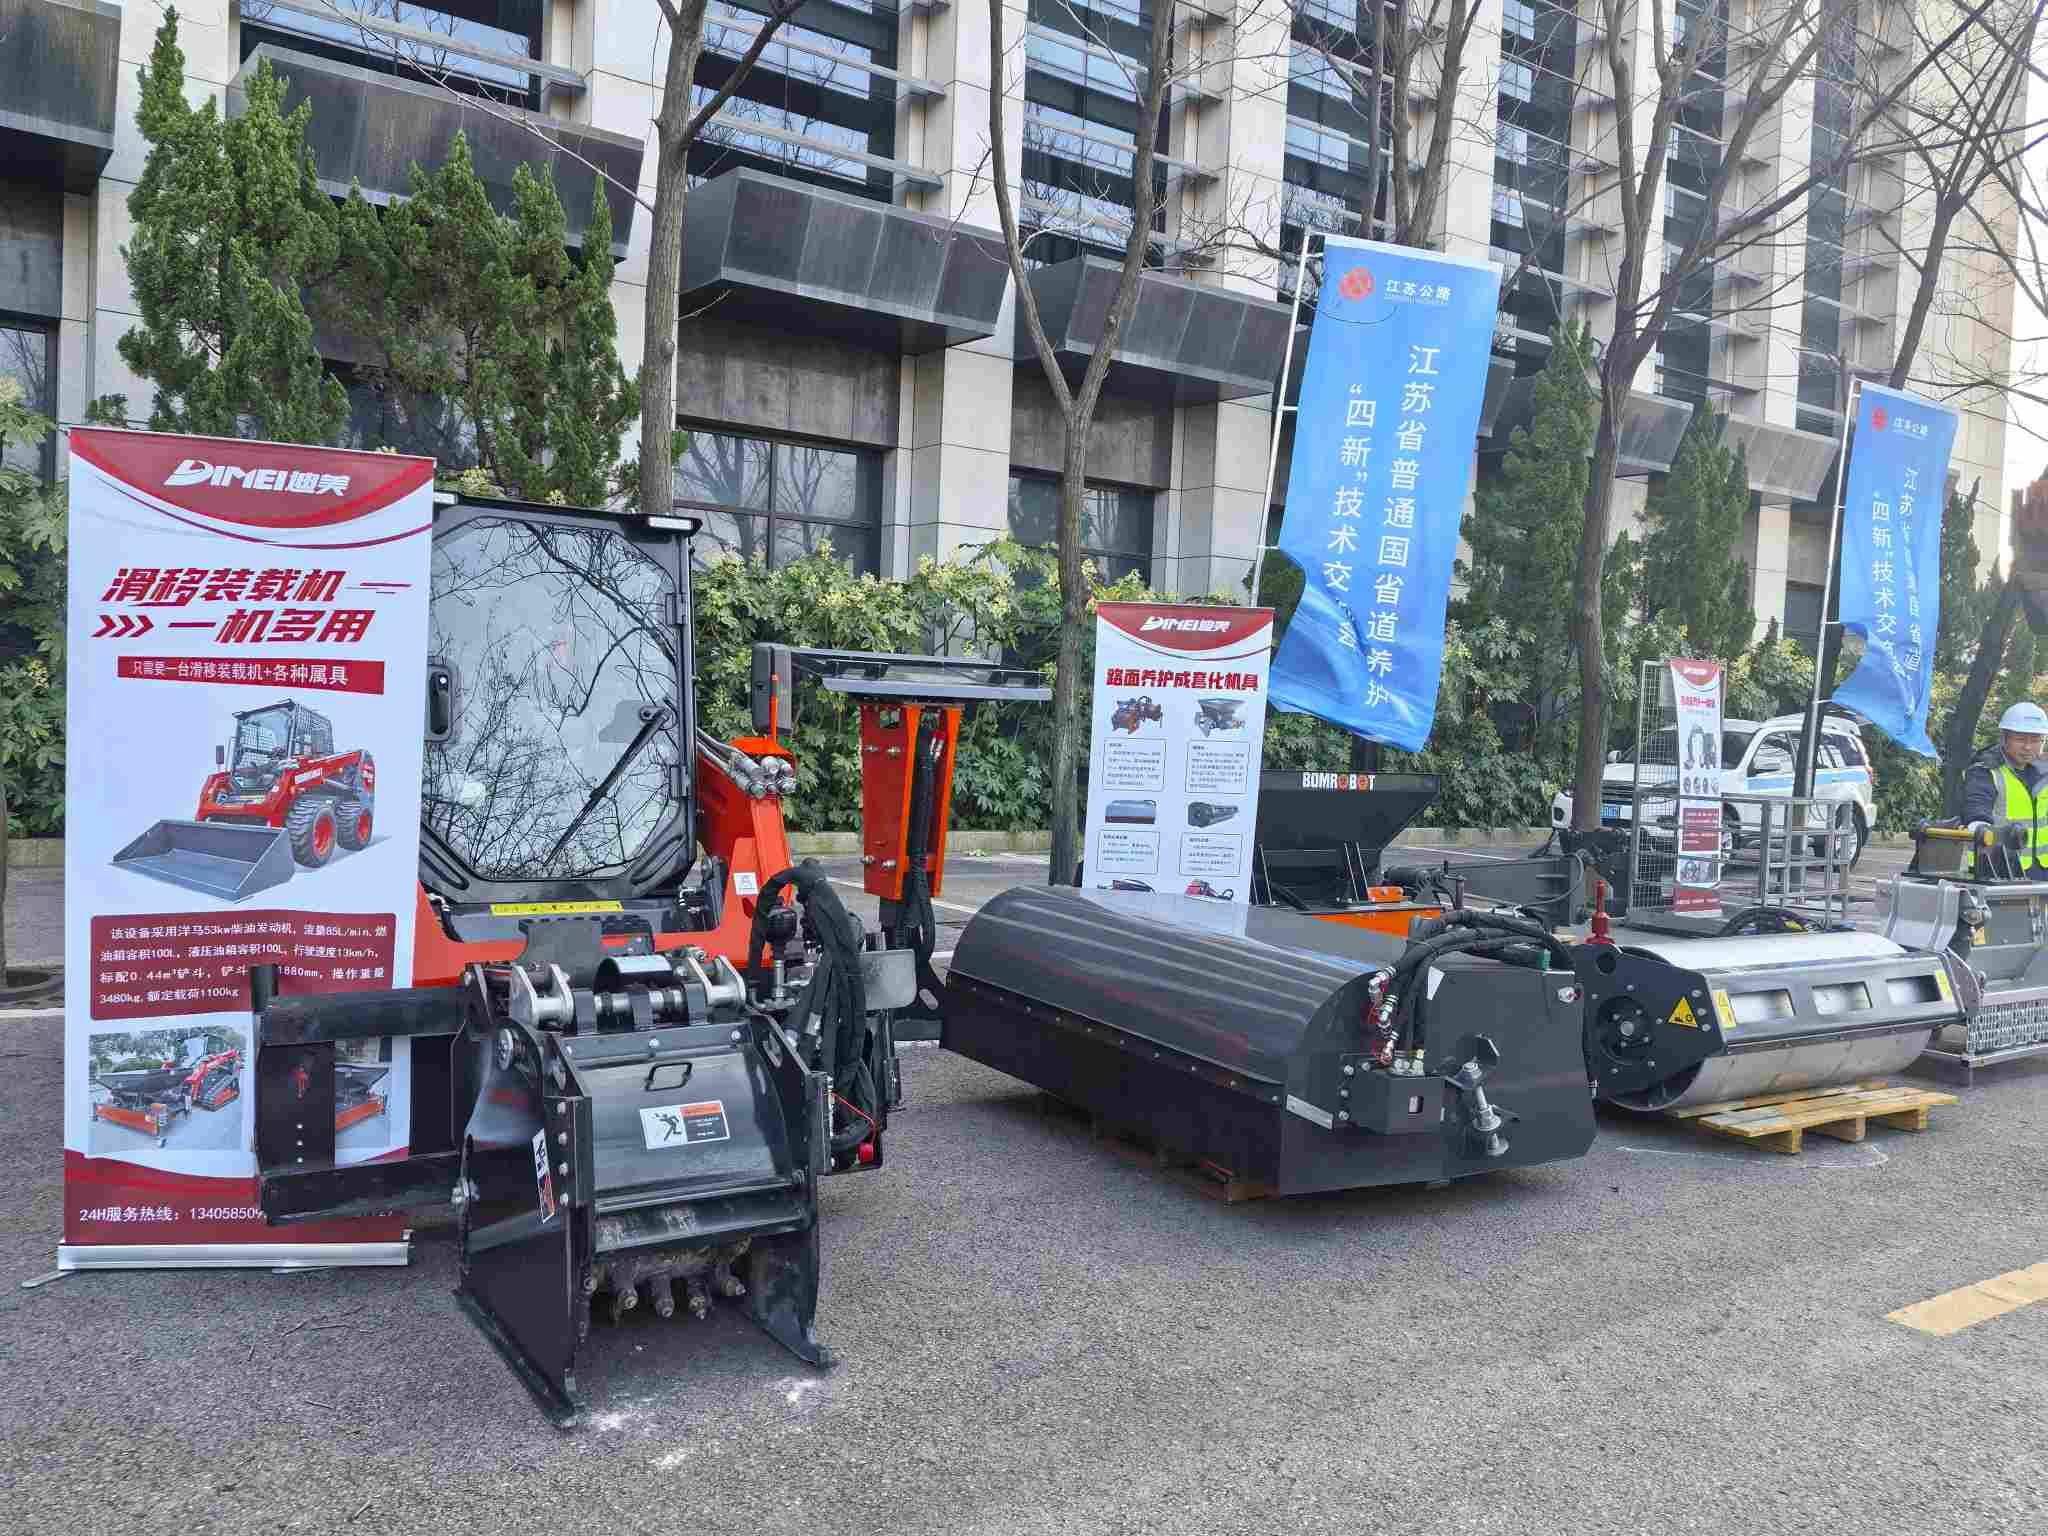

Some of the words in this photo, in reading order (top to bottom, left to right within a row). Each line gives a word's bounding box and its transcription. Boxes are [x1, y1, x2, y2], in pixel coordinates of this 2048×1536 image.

[1385, 279, 1450, 301] 江苏公路
[1323, 384, 1377, 650] “四新”技术交会
[1366, 343, 1440, 707] 江苏省普通国省道养护
[100, 568, 346, 603] 滑移装载机
[167, 609, 376, 643] 一机多用
[132, 660, 348, 686] 只需要一台滑移装载机+各种属具
[1105, 668, 1259, 691] 路面养护成套化机具
[1302, 772, 1376, 790] BOMROBOT
